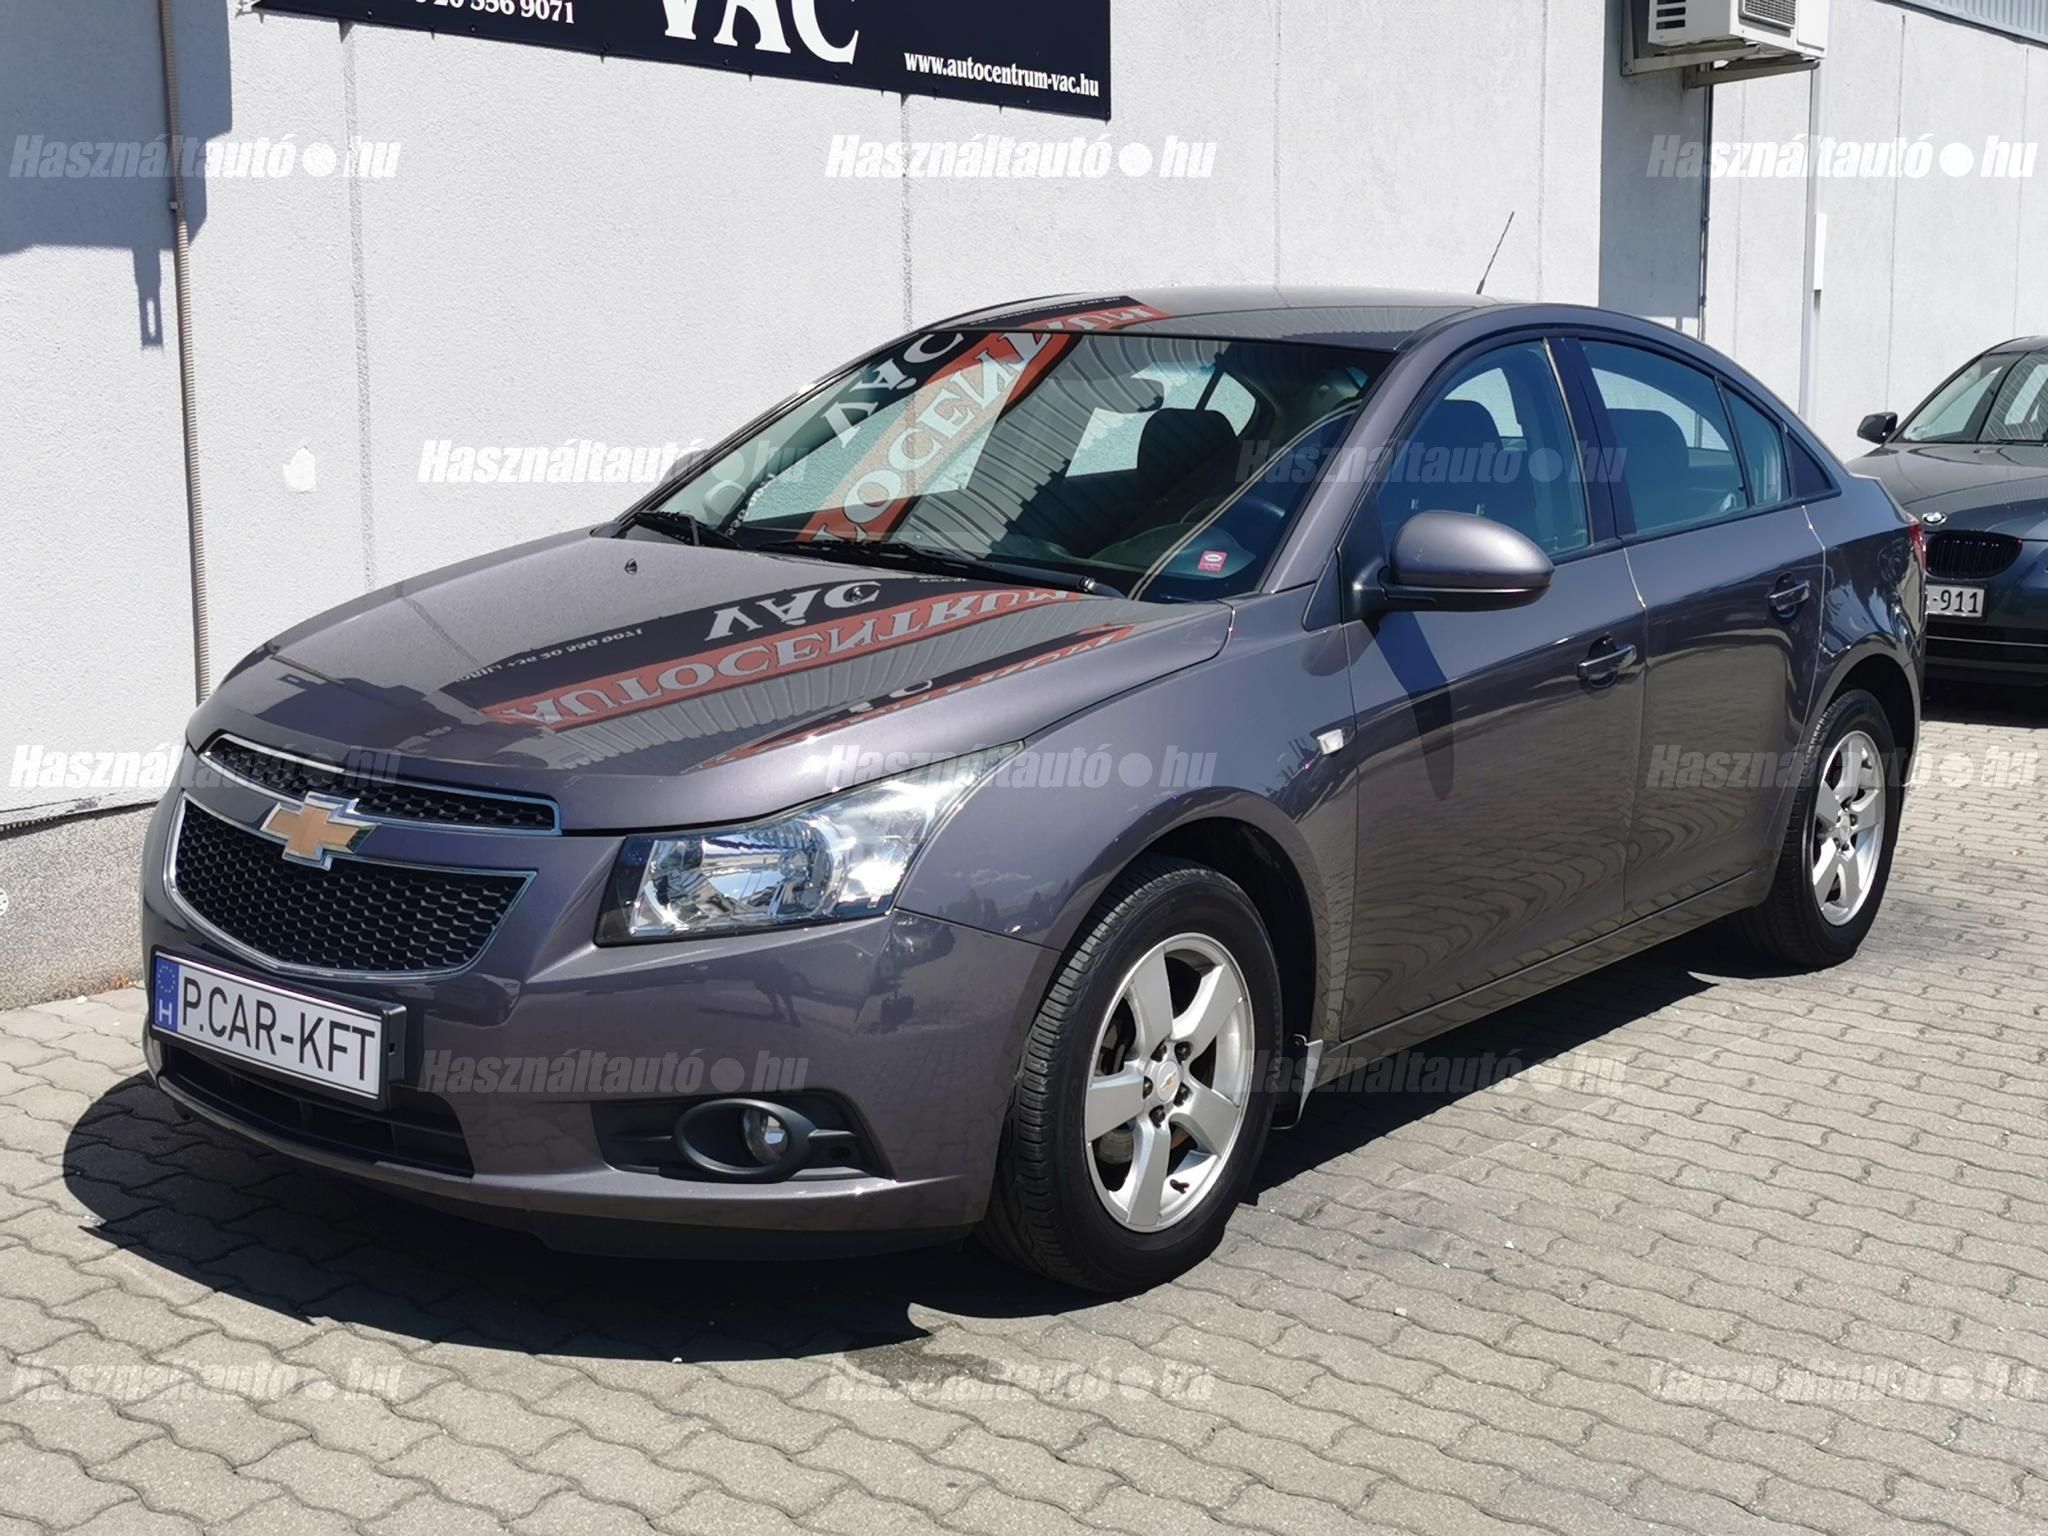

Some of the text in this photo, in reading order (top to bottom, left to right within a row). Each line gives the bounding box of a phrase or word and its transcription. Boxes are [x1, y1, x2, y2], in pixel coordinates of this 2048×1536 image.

[520, 0, 575, 24] 9071
[904, 52, 1100, 97] www.autocentrum-vac.hu
[159, 999, 173, 1026] H
